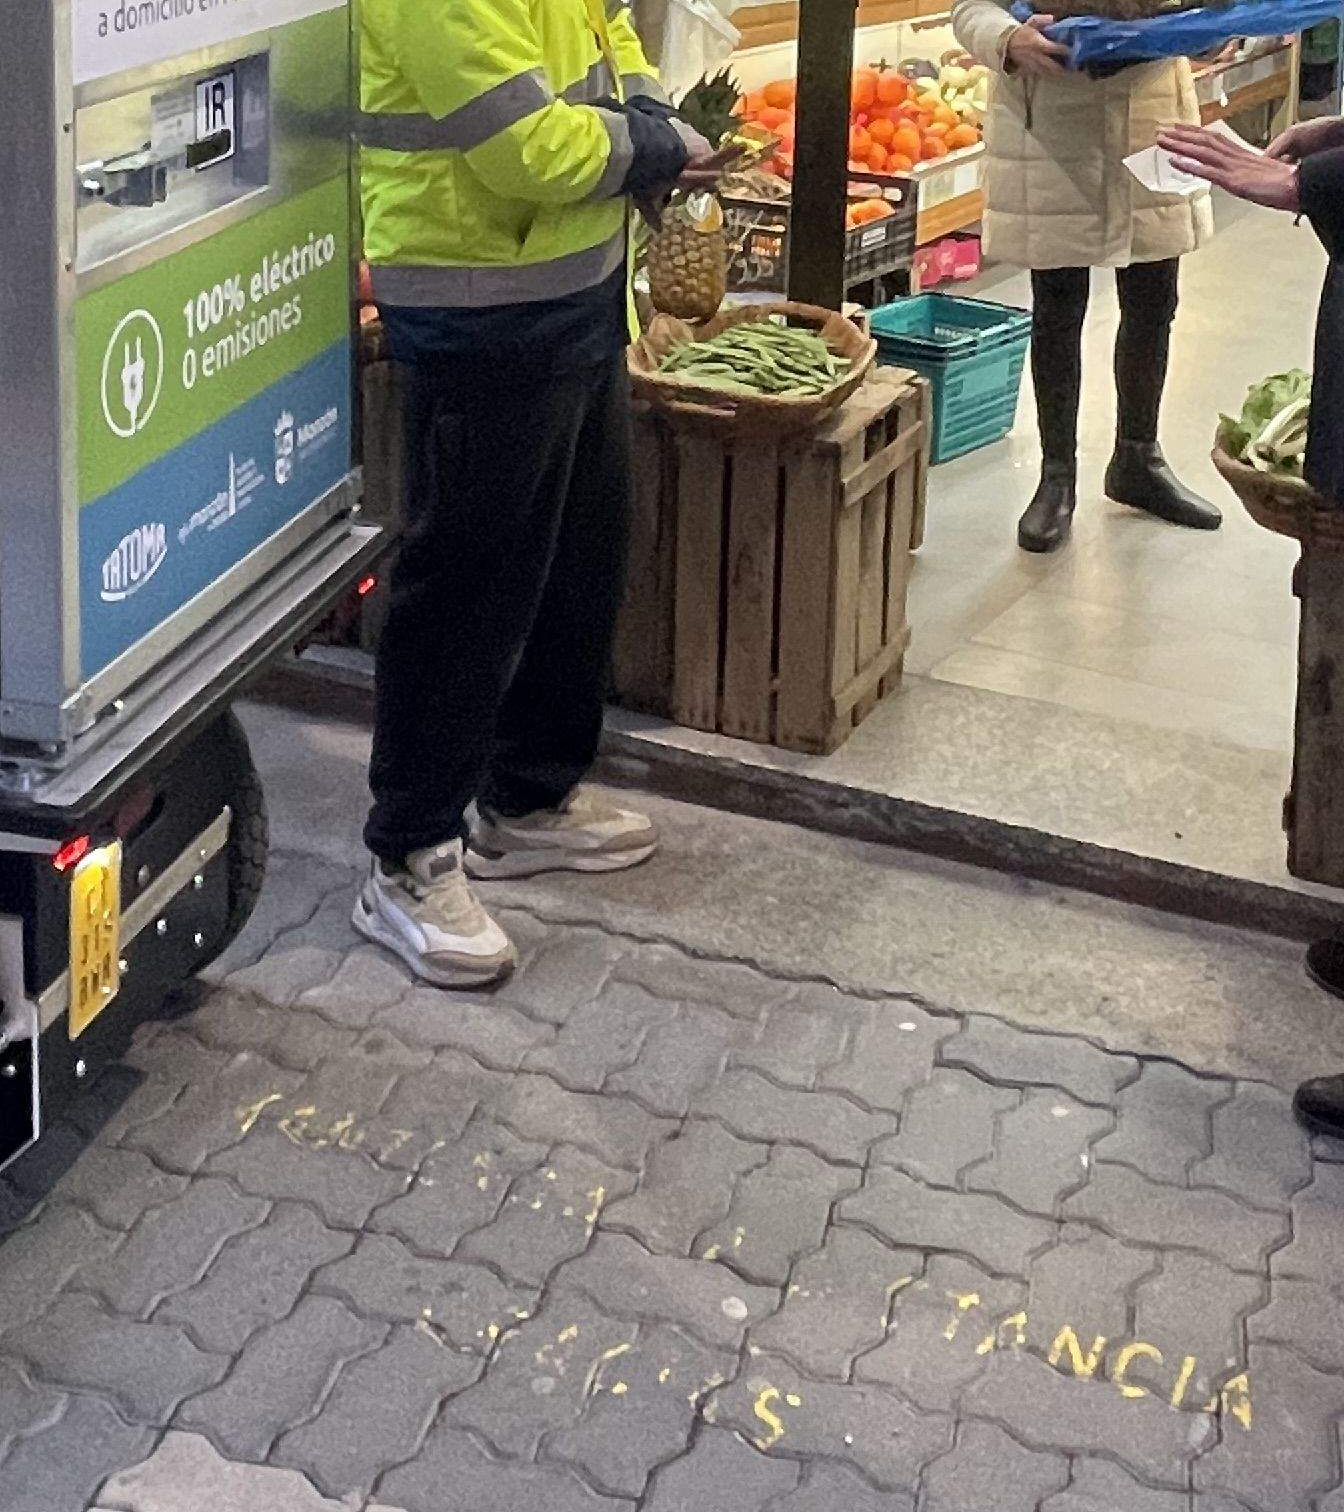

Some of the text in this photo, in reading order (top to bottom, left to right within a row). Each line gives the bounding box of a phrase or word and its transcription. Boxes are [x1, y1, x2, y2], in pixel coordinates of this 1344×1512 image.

[98, 11, 108, 38] a
[183, 232, 335, 339] 100% eléctrico
[182, 295, 302, 390] 0 emisiones
